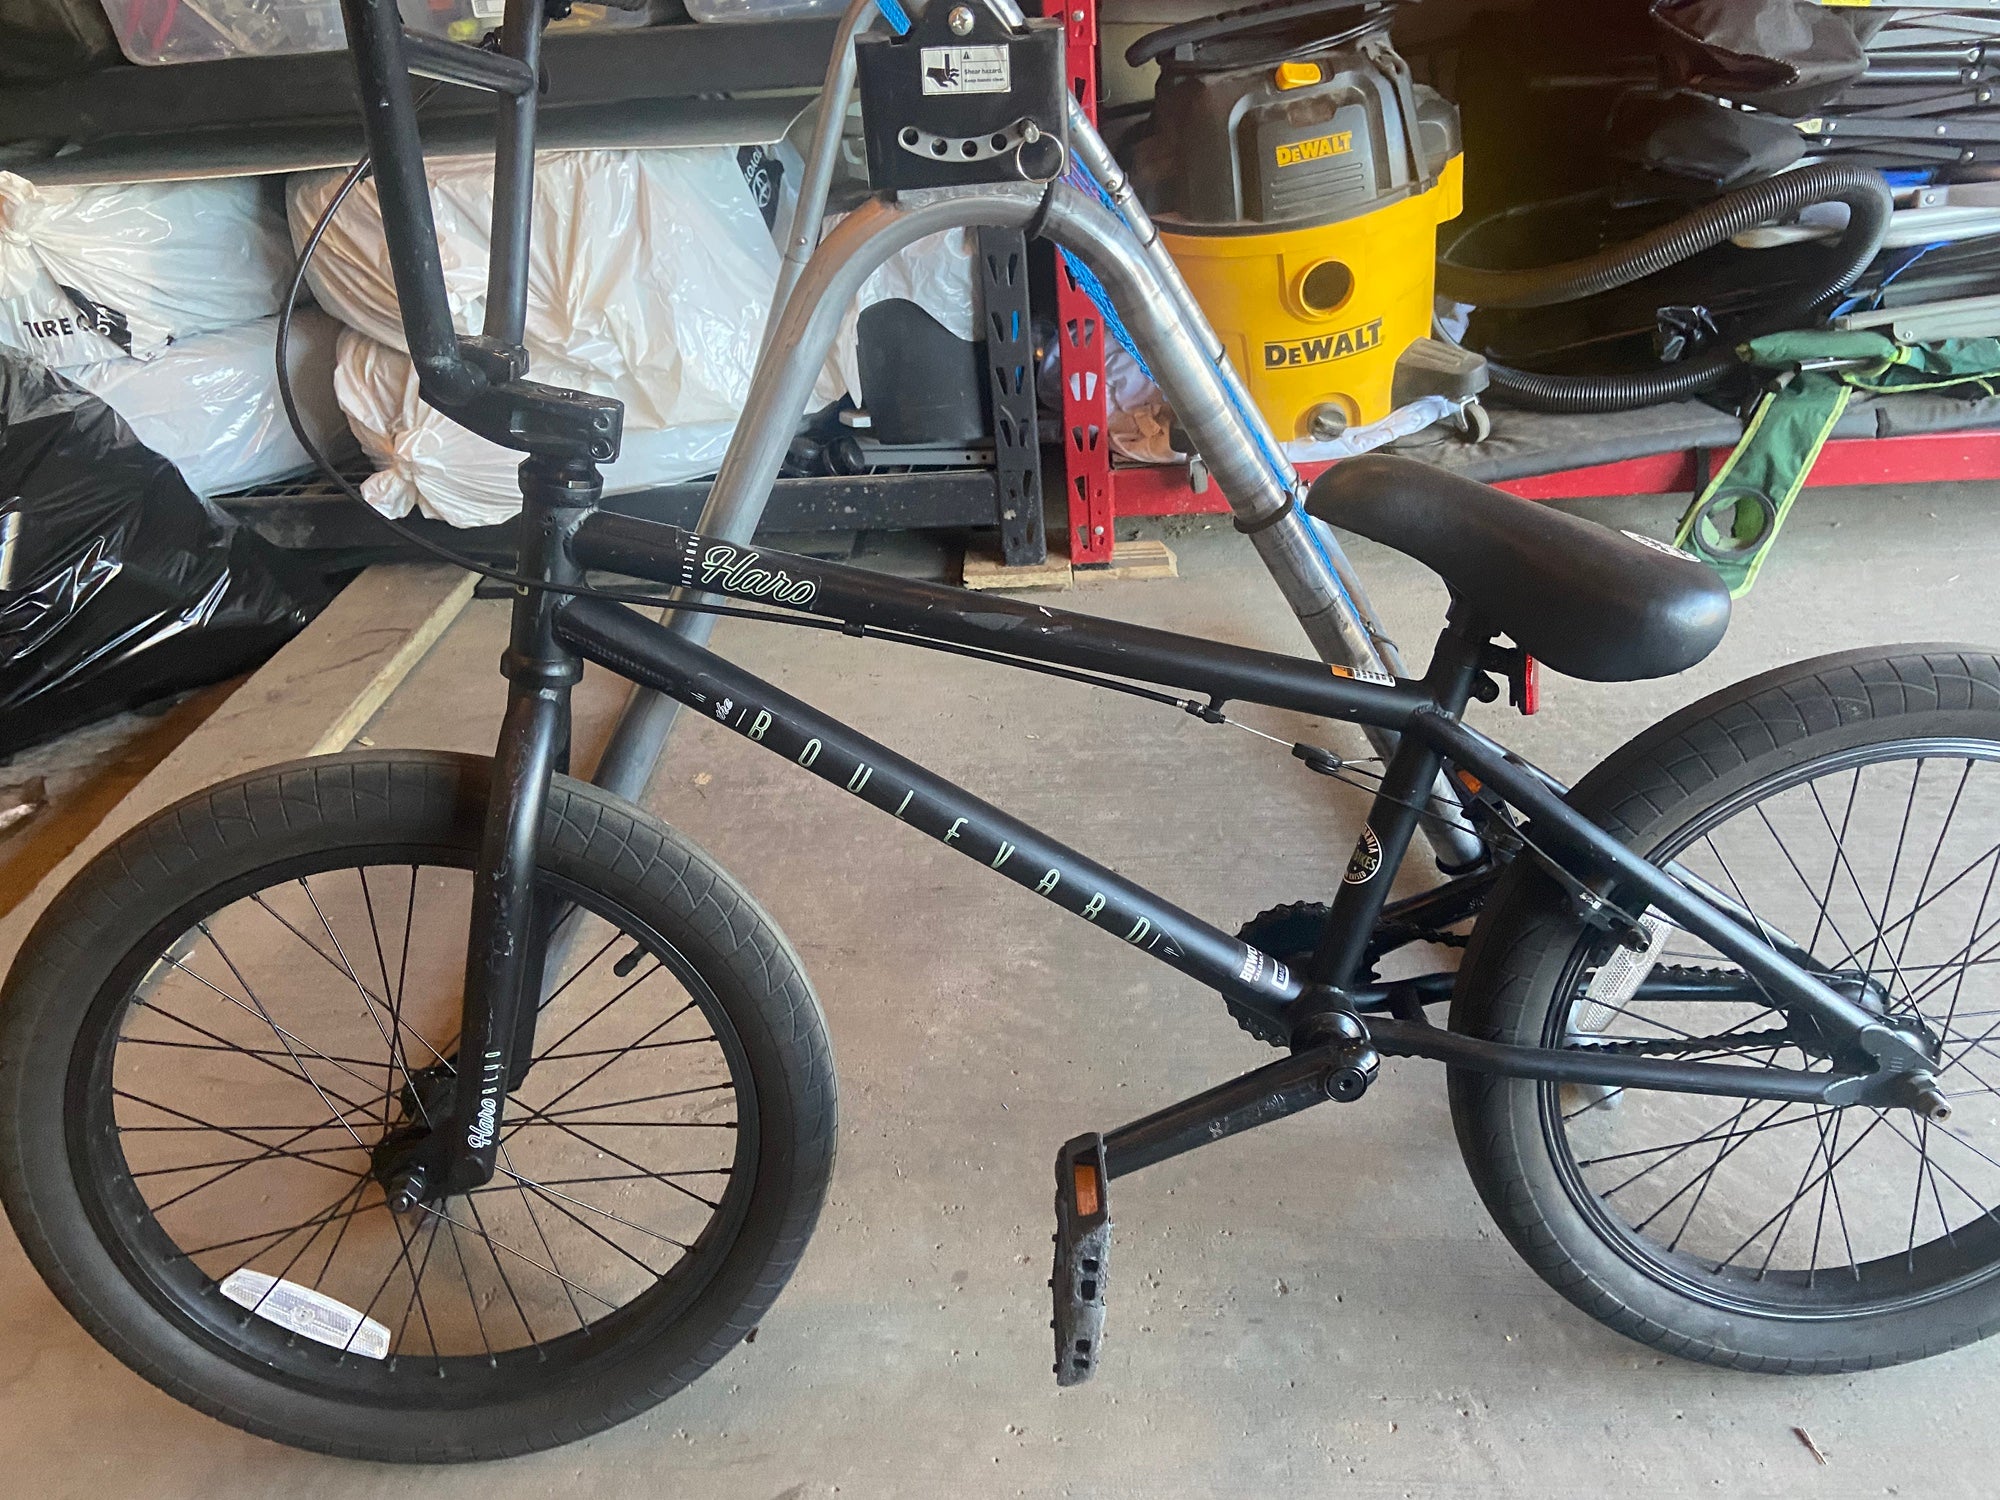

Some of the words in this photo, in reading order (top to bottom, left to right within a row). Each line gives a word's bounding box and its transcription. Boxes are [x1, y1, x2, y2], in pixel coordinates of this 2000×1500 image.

[744, 146, 763, 184] TOYOT
[23, 317, 74, 338] TIRE
[701, 545, 816, 604] Haro
[715, 697, 734, 720] the
[747, 709, 1151, 944] BOULEVARD
[467, 1098, 497, 1149] Haro
